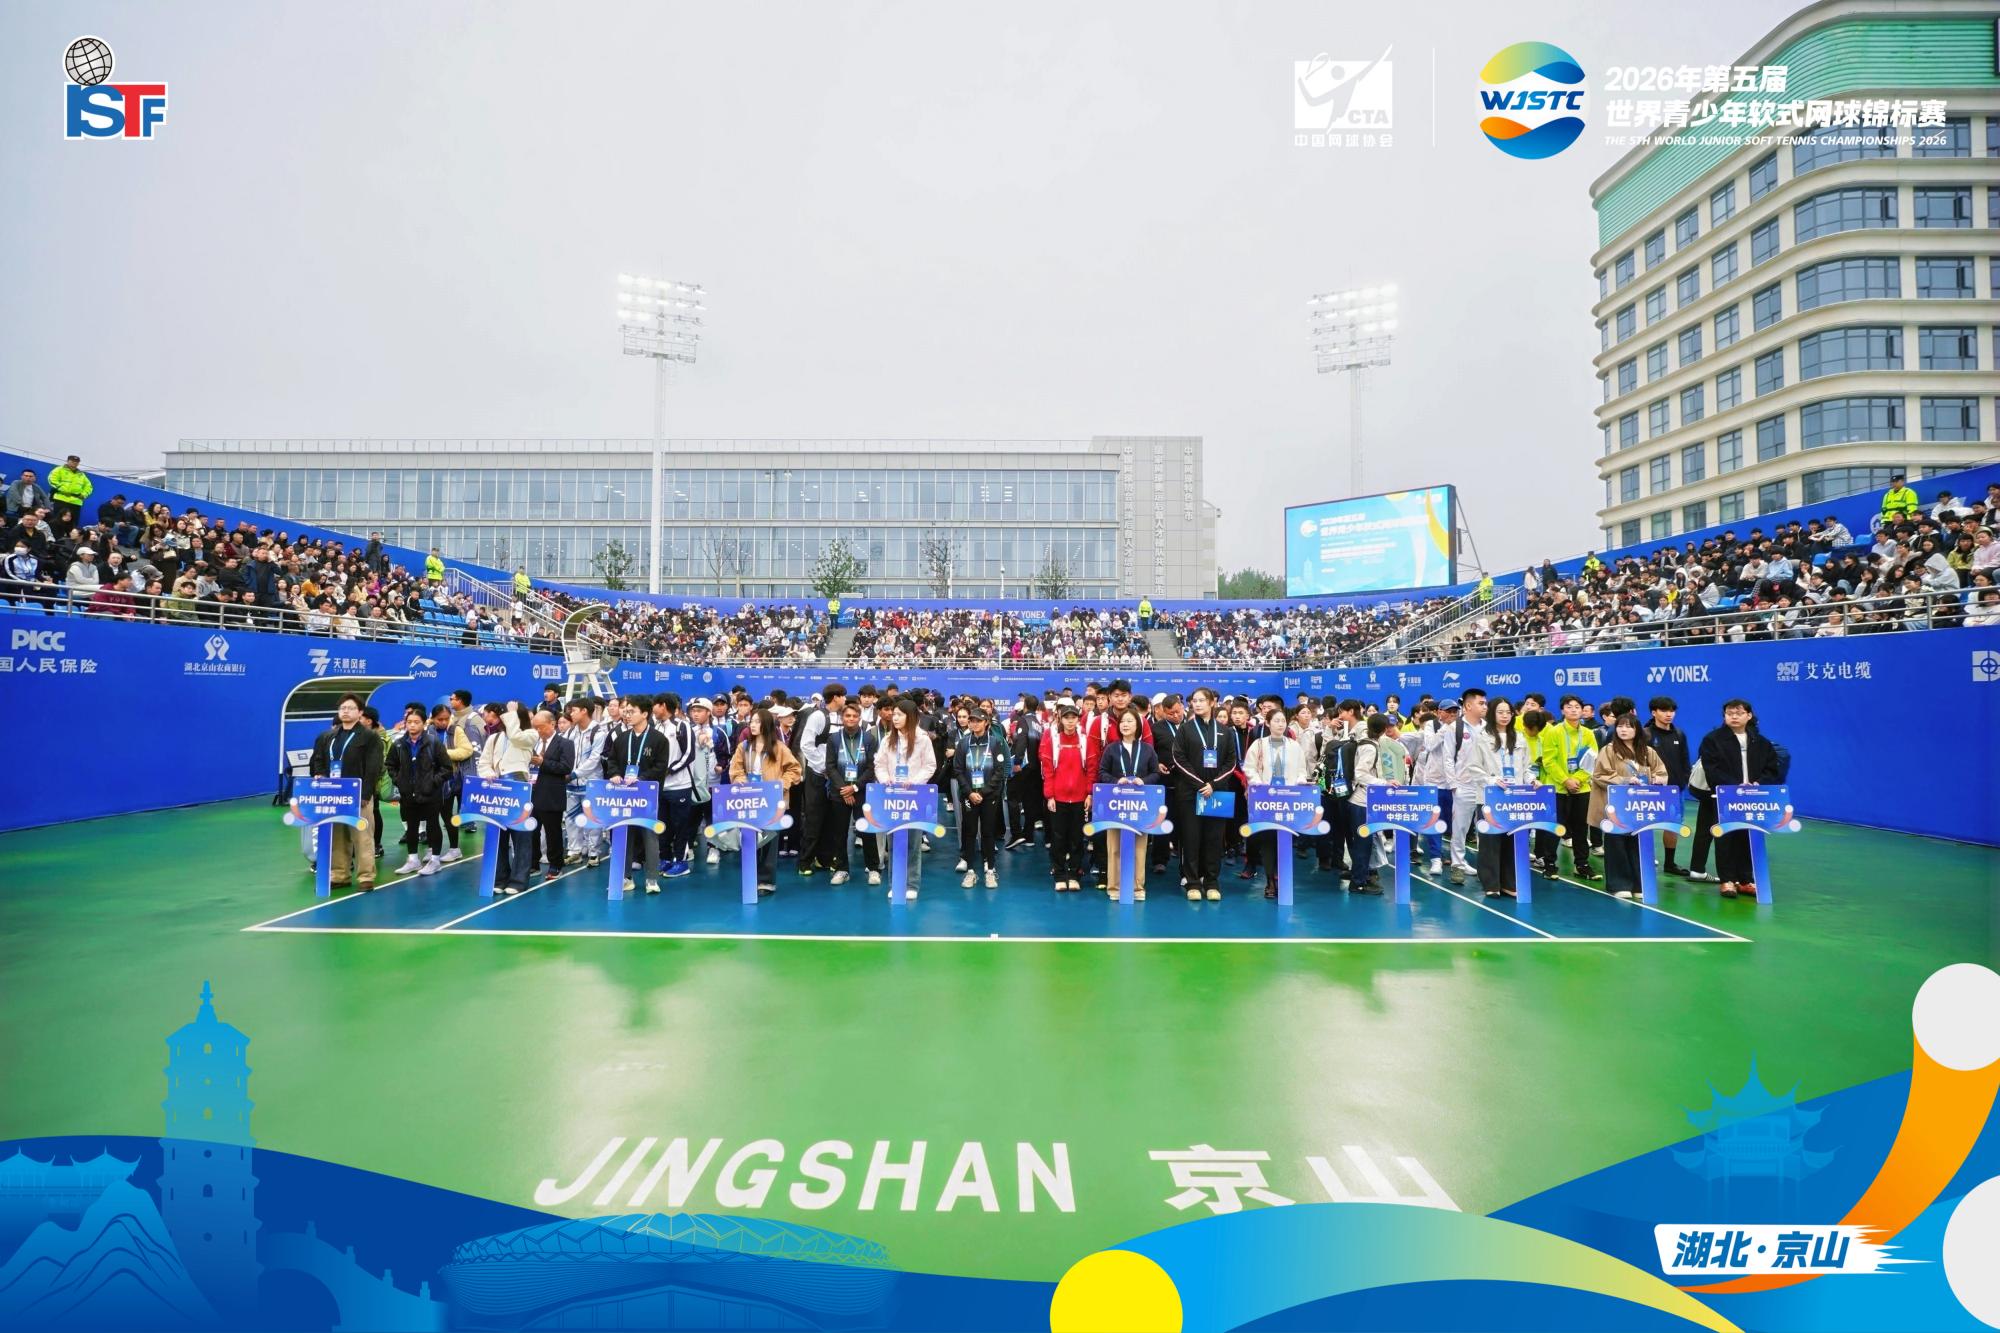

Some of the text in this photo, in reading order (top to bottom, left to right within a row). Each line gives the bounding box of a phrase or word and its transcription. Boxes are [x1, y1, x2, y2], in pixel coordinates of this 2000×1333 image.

[1020, 610, 1046, 619] YONEX
[11, 628, 66, 652] PICC
[471, 664, 507, 676] KENKO
[1669, 665, 1709, 683] YONEX
[1777, 661, 1800, 676] 950
[1805, 661, 1872, 680] 艾克电缆
[1486, 673, 1521, 685] KENKO
[298, 795, 354, 805] PHILIPPINES
[470, 793, 520, 807] MALAYSIA
[595, 797, 648, 807] THAILAND
[726, 797, 769, 810] KOREA
[884, 799, 918, 811] INDIA
[1108, 799, 1149, 811] CHINA
[480, 805, 509, 816] 马来西亚
[1255, 801, 1315, 811] KOREA DPR
[1372, 803, 1407, 812] CHINESE
[1495, 802, 1546, 811] CAMBODIA
[1625, 801, 1665, 811] JAPAN
[1728, 802, 1780, 811] MONGOLIA
[1119, 812, 1138, 821] 中国
[1386, 813, 1419, 821] 中华台北
[1636, 812, 1656, 821] 日本
[534, 1136, 1076, 1211] JINGSHAN
[1148, 1142, 1460, 1214] 京山
